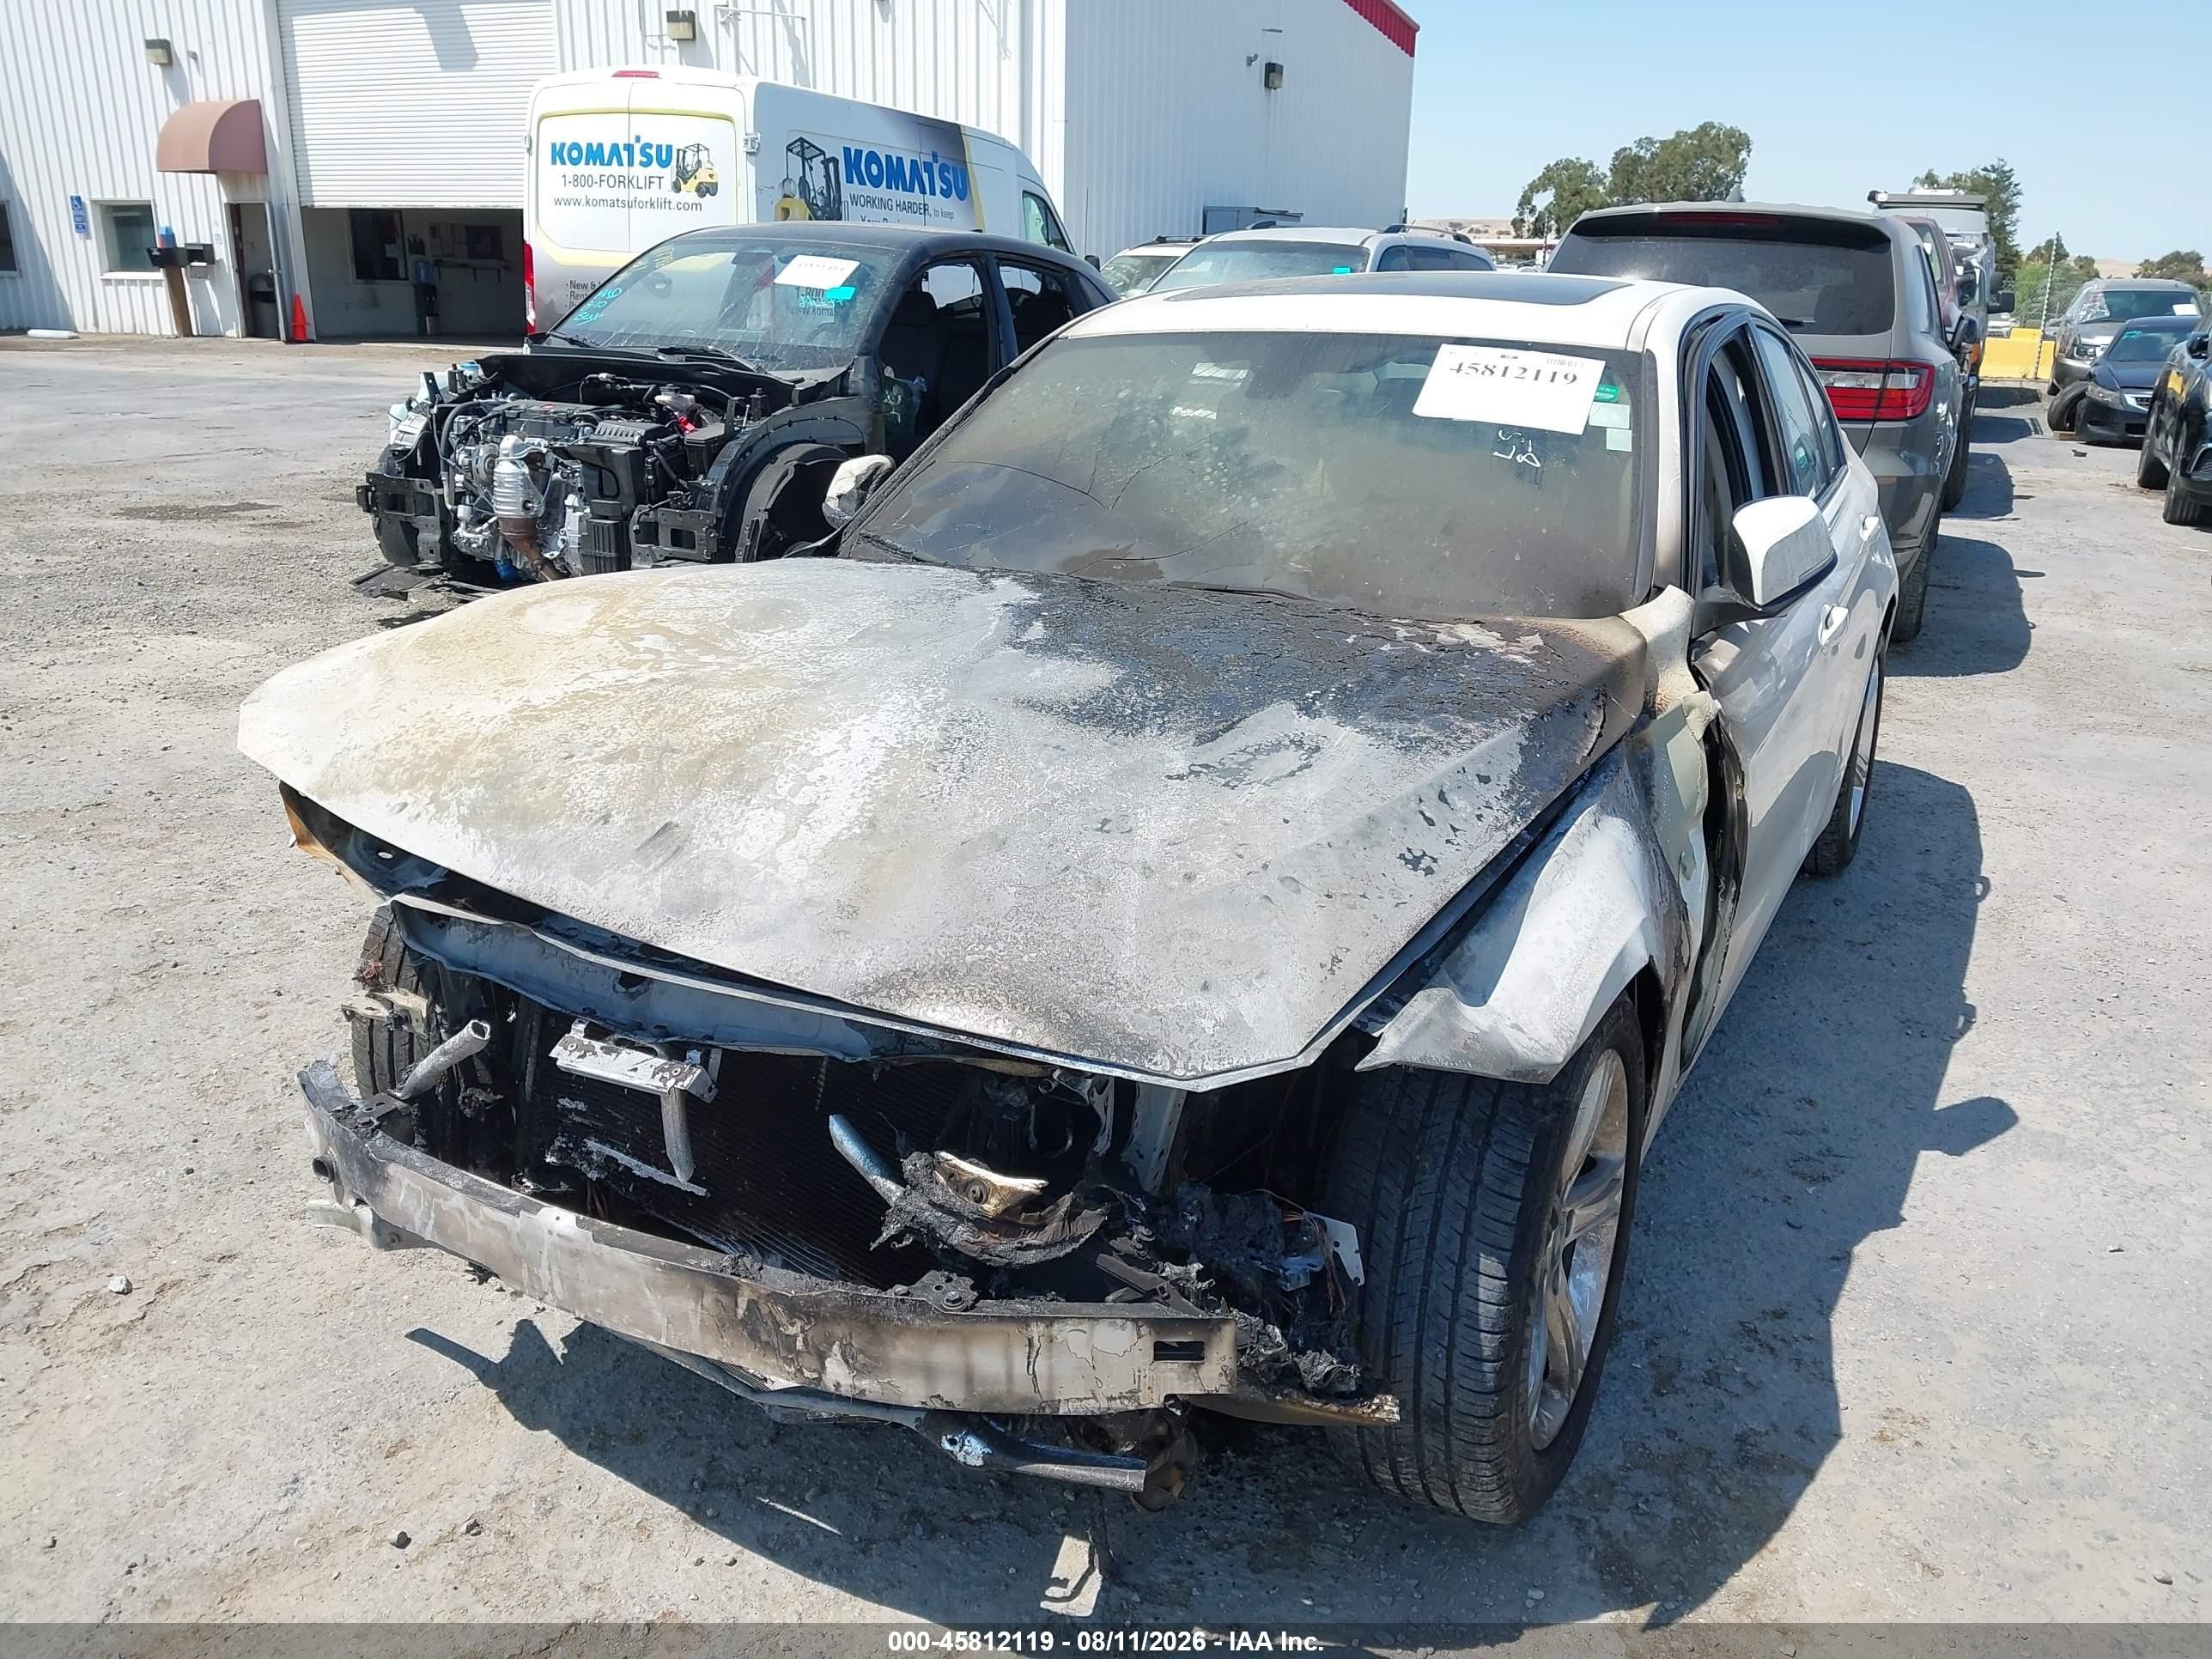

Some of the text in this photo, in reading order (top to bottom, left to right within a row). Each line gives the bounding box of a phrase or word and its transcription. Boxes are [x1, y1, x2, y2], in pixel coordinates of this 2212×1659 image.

[550, 135, 673, 168] KOMATSU
[562, 174, 665, 190] 1-800-FORKLIFT
[842, 147, 968, 202] KOMATSU
[553, 196, 702, 212] www.komatsuforklift.com
[849, 192, 955, 220] WORKING HARDER, to keep
[569, 280, 588, 289] New
[590, 281, 596, 289] &
[1449, 362, 1577, 385] 45812119
